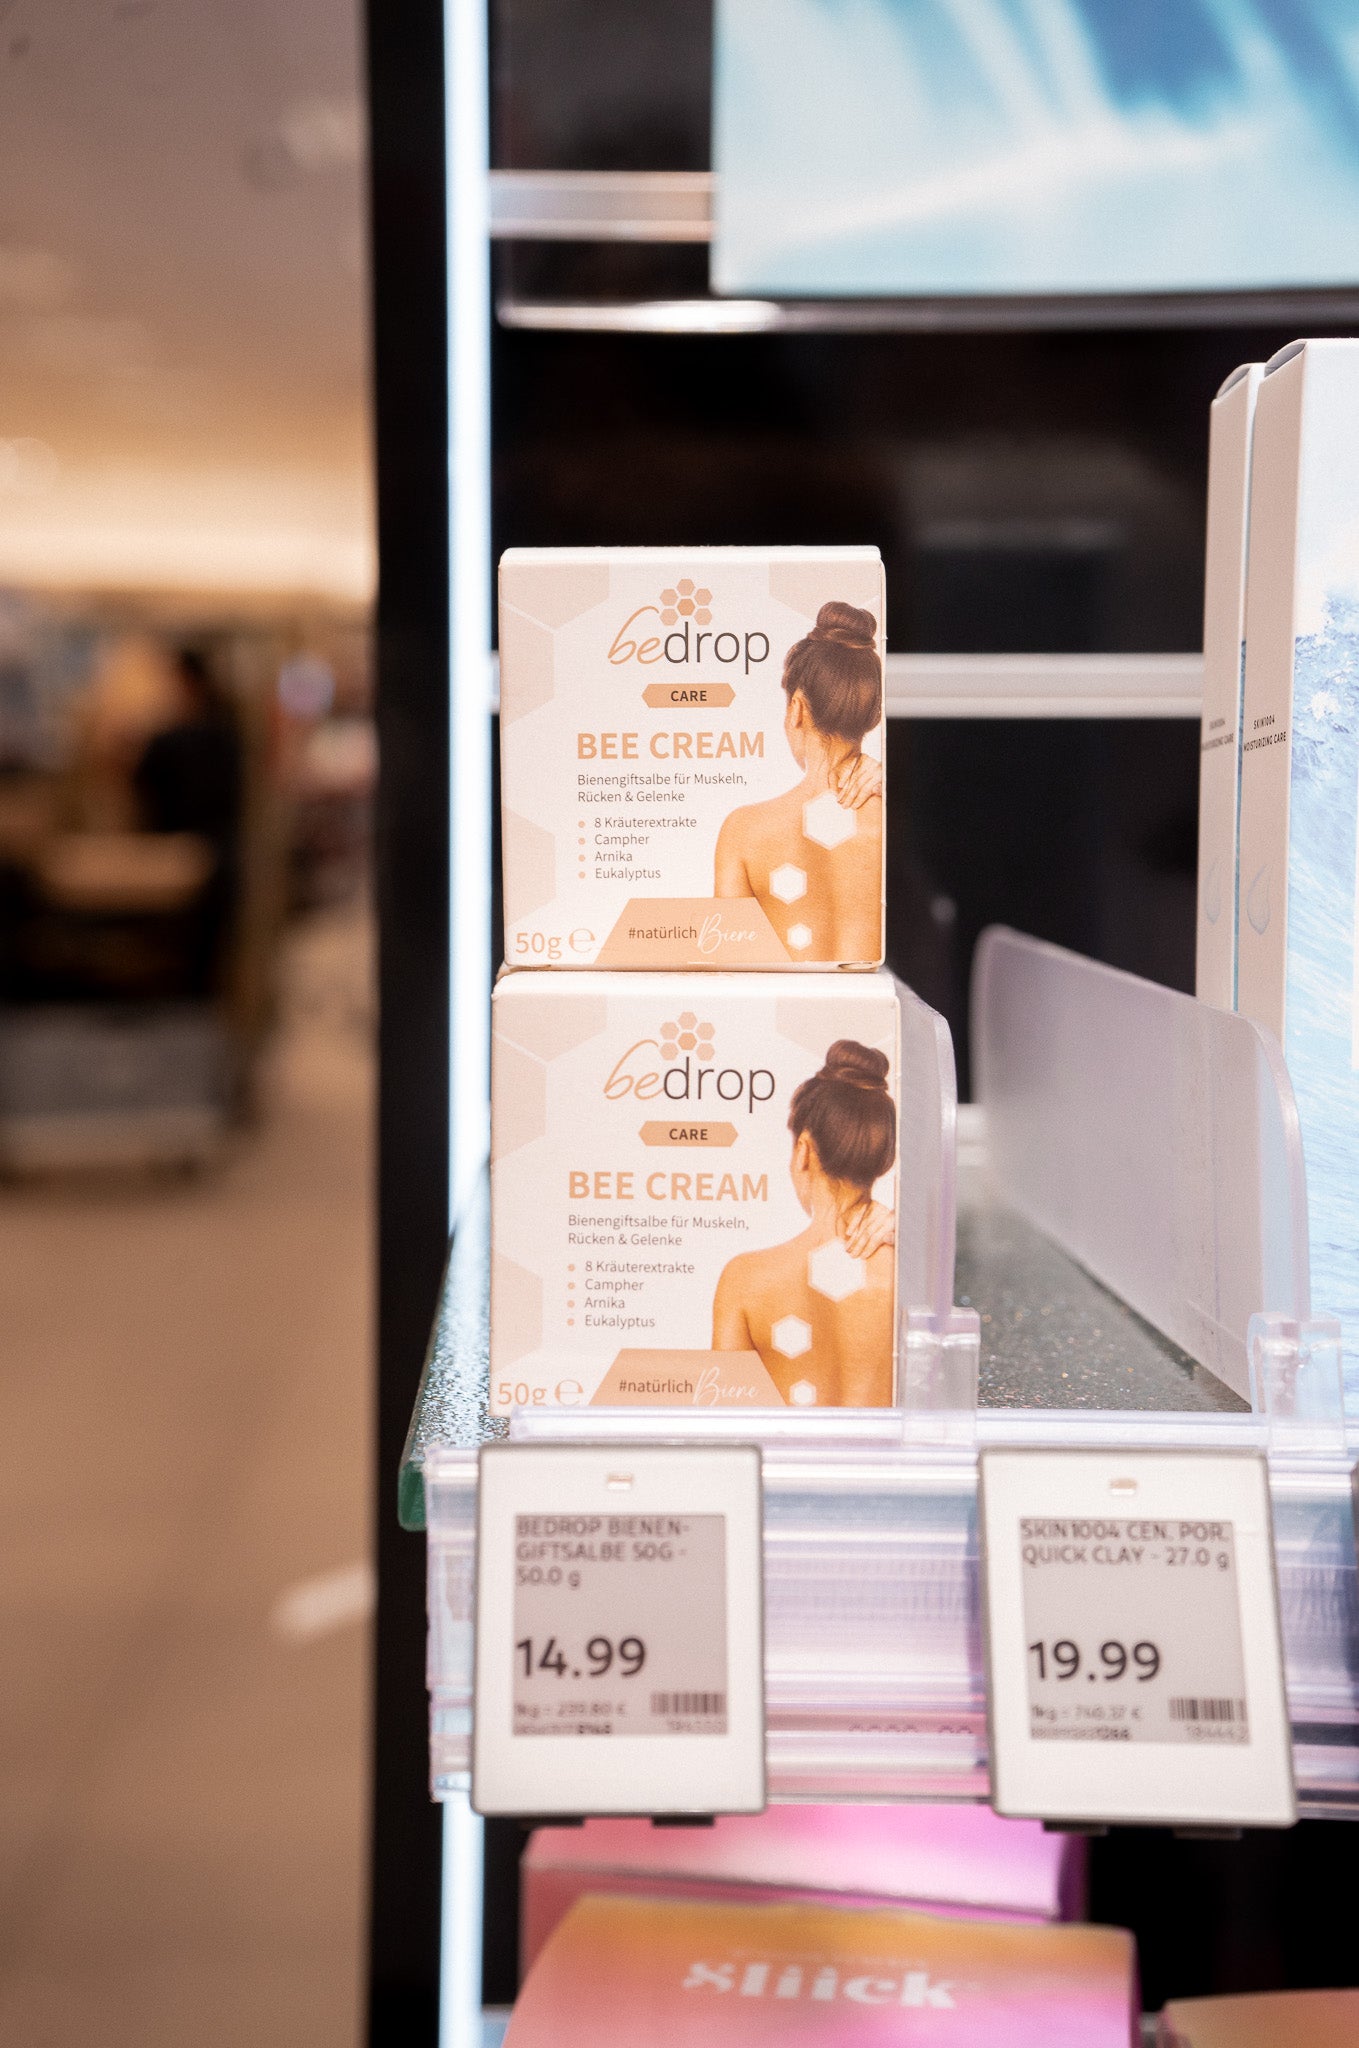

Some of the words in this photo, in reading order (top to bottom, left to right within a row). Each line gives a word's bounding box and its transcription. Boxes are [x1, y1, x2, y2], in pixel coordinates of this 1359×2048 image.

[607, 606, 770, 675] bedrop
[670, 690, 708, 702] CARE
[577, 732, 639, 759] BEE
[649, 731, 765, 758] CREAM
[1273, 731, 1287, 744] CARE
[577, 773, 671, 788] Bienengiftsalbe
[674, 773, 690, 785] für
[694, 773, 747, 786] Muskeln,
[577, 789, 622, 803] Rücken
[625, 791, 633, 802] &
[636, 791, 685, 803] Gelenke
[594, 817, 601, 828] 8
[604, 815, 697, 828] Kräuterextrakte
[594, 834, 650, 848] Campher
[594, 850, 633, 863] Arnika
[595, 867, 661, 882] Eukalyptus
[515, 933, 562, 959] 50g
[603, 1039, 776, 1113] bedrop
[669, 1128, 708, 1140] CARE
[568, 1171, 635, 1200] BEE
[646, 1172, 769, 1202] CREAM
[568, 1214, 668, 1230] Bienengiftsalbe
[671, 1215, 689, 1228] für
[692, 1217, 750, 1231] Muskeln,
[568, 1232, 616, 1246] Rücken
[619, 1234, 628, 1245] &
[630, 1233, 683, 1246] Gelenke
[585, 1261, 593, 1272] 8
[596, 1260, 695, 1274] Kräuterextrakte
[585, 1278, 644, 1294] Campher
[585, 1296, 625, 1309] Arnika
[585, 1315, 655, 1329] Eukalyptus
[498, 1381, 547, 1406] 50g
[518, 1519, 601, 1537] BEDROP
[608, 1519, 690, 1537] BIENEN-
[1021, 1522, 1120, 1540] SKIN1004
[1127, 1522, 1173, 1541] CEN.
[1179, 1523, 1230, 1542] POR.
[517, 1542, 626, 1561] GIFTSALBE
[1023, 1546, 1088, 1568] QUICK
[1092, 1546, 1144, 1565] CLAY
[1166, 1546, 1211, 1566] 27.0
[1216, 1553, 1230, 1571] g
[517, 1566, 562, 1586] 50.0
[568, 1571, 581, 1588] g
[517, 1637, 647, 1678] 14.99
[1029, 1640, 1161, 1682] 19.99
